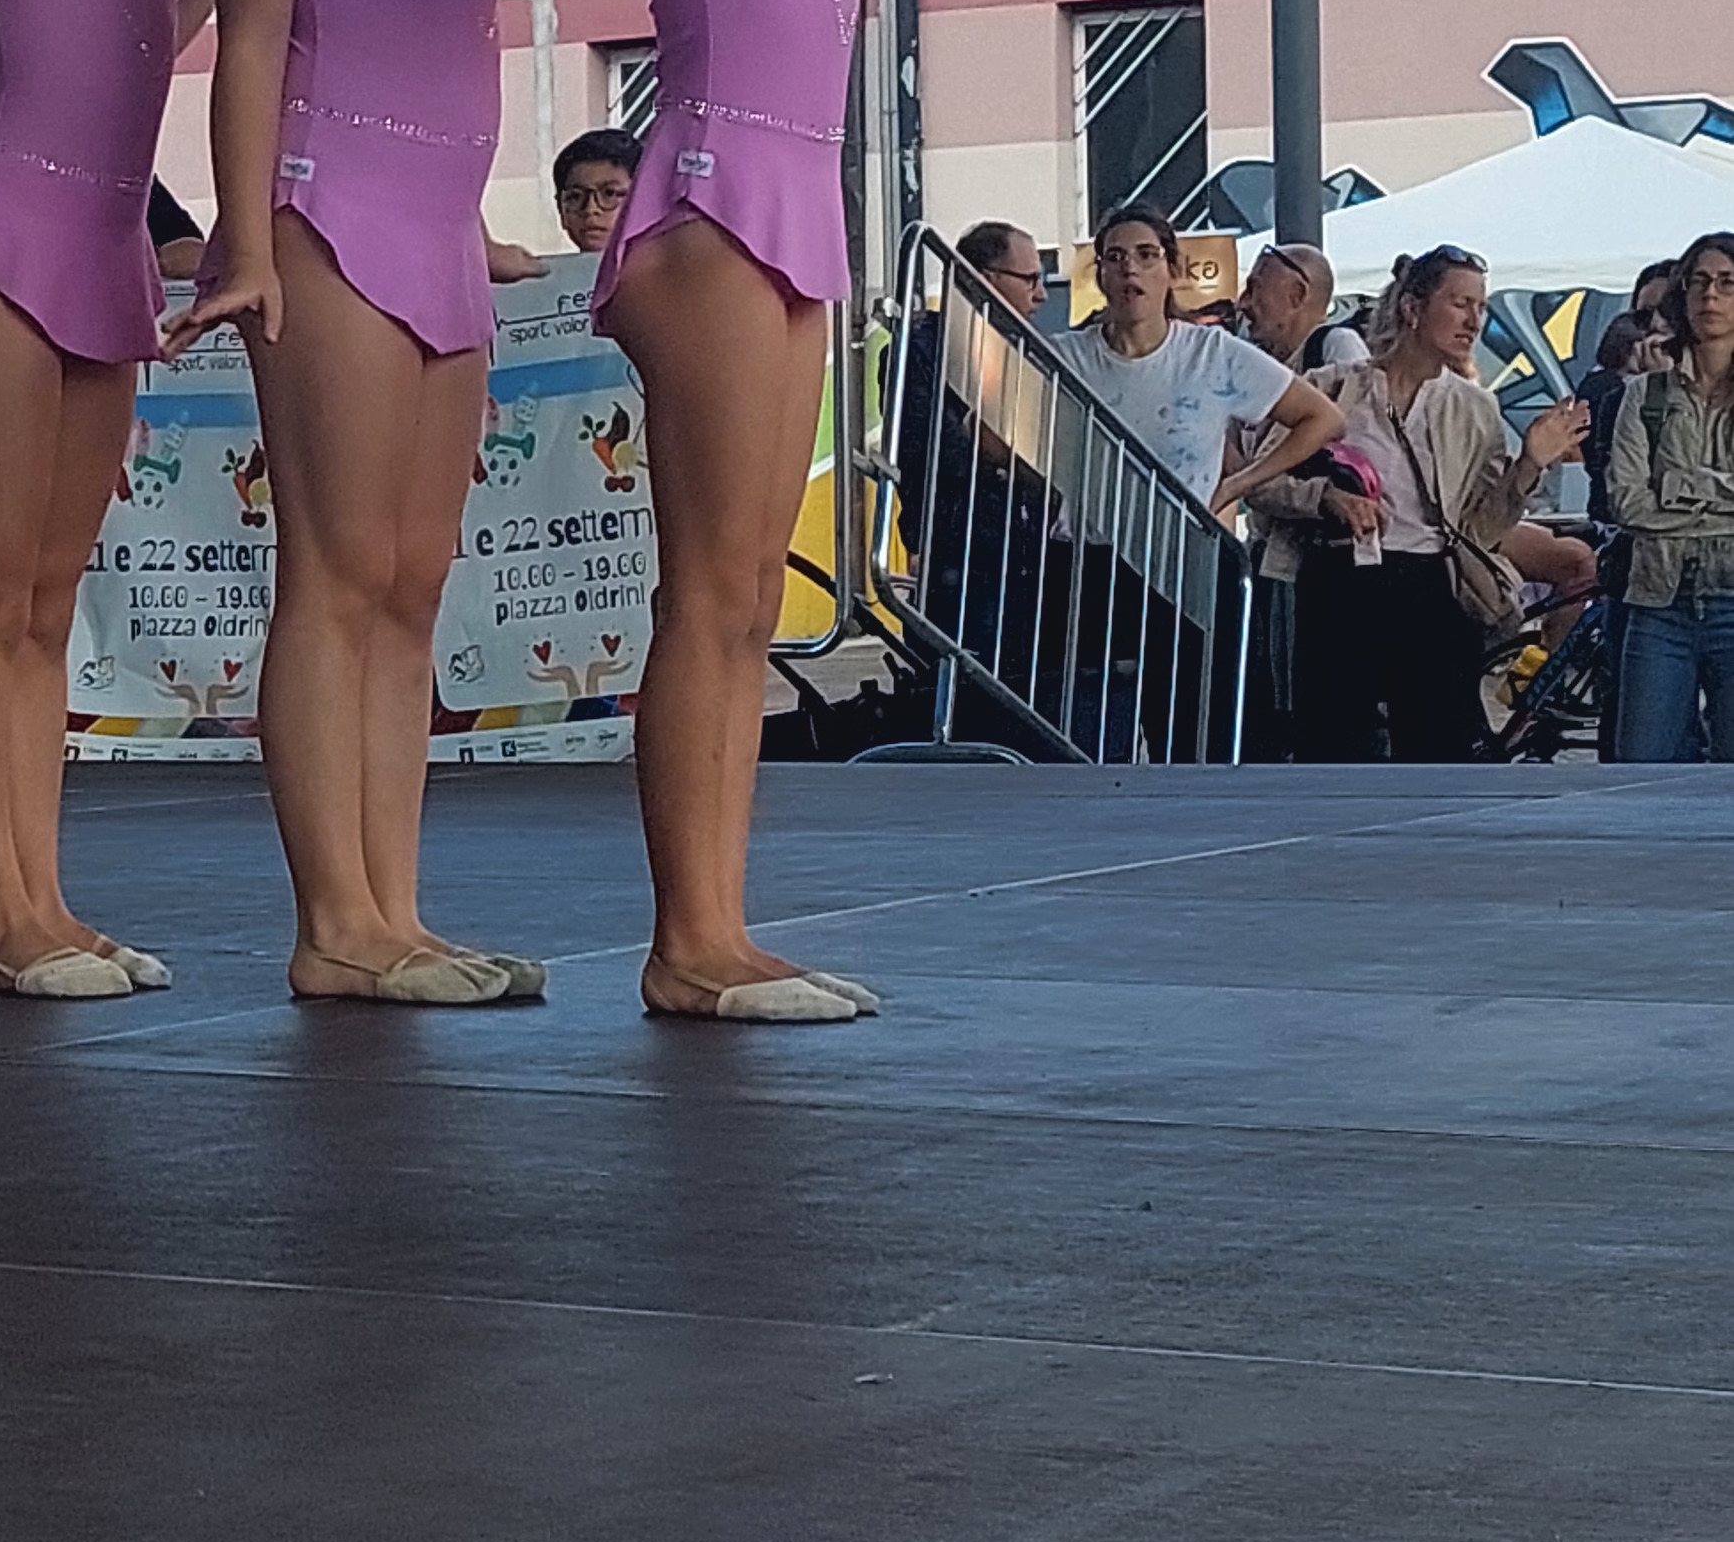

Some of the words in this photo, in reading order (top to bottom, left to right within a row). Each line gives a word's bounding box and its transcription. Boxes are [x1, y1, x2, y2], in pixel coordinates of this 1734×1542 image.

[476, 528, 494, 556] e
[502, 517, 540, 553] 22
[85, 540, 108, 572] 1
[115, 545, 132, 572] e
[138, 539, 176, 571] 22
[583, 552, 646, 582] 19.00
[129, 586, 188, 609] 10.00
[495, 594, 566, 626] piazza
[575, 582, 645, 612] Oldrini
[130, 615, 196, 642] piazza
